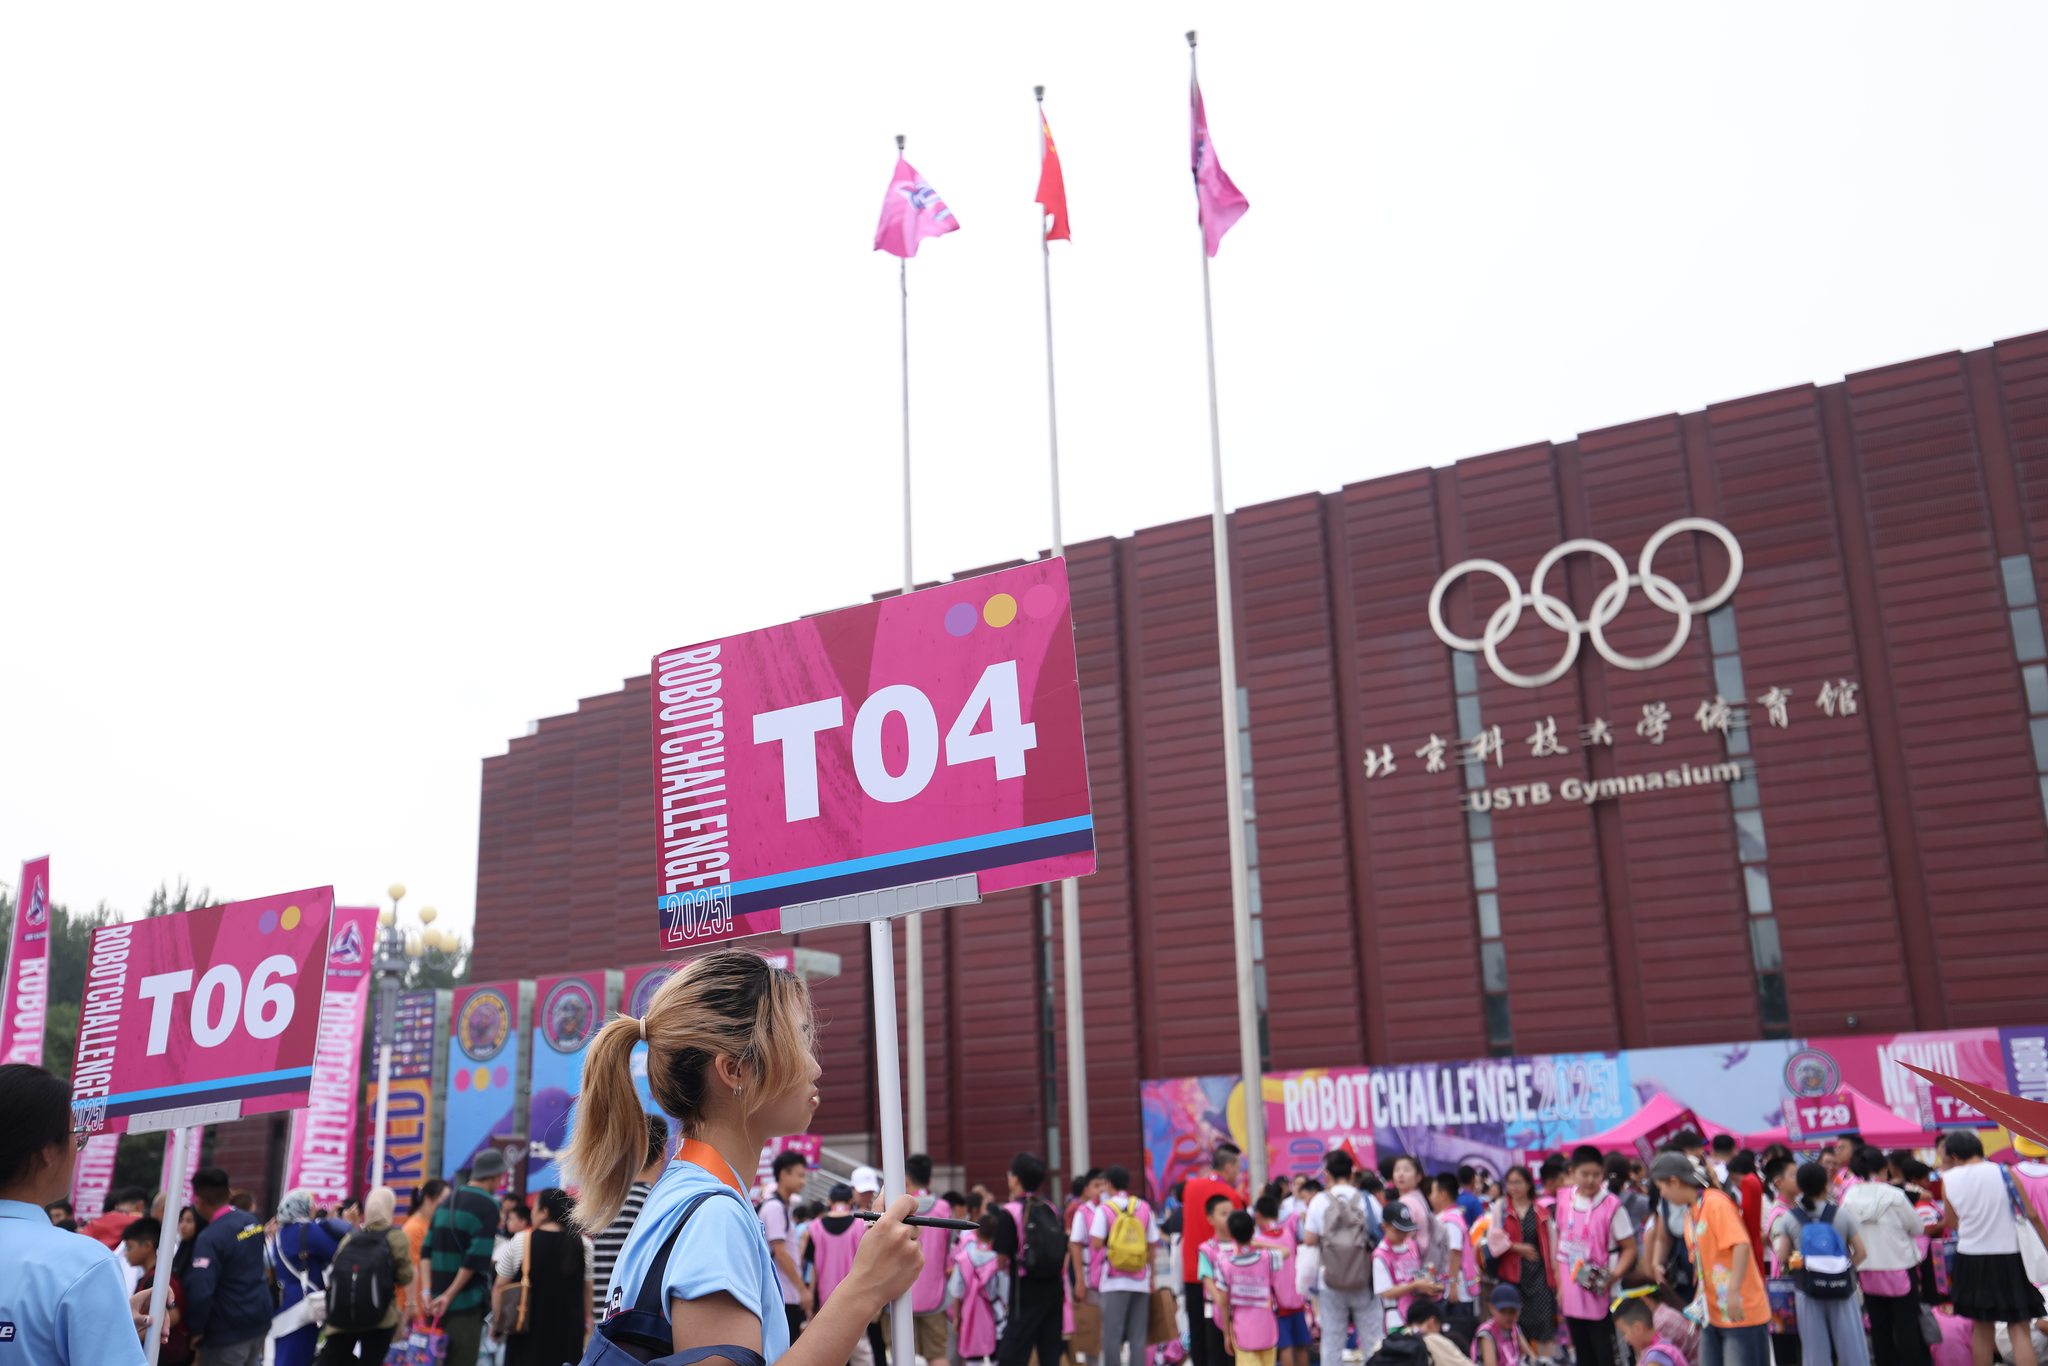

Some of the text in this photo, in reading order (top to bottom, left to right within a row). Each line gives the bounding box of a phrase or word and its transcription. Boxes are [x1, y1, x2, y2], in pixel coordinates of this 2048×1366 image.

[658, 643, 734, 943] ROBOTCHALLENGE 2025!
[752, 659, 1038, 824] T04
[1471, 762, 1742, 814] USTB Gymnasium
[72, 925, 133, 1100] ROBOTCHALLENGE
[139, 954, 298, 1057] T06
[1801, 1104, 1851, 1128] T29
